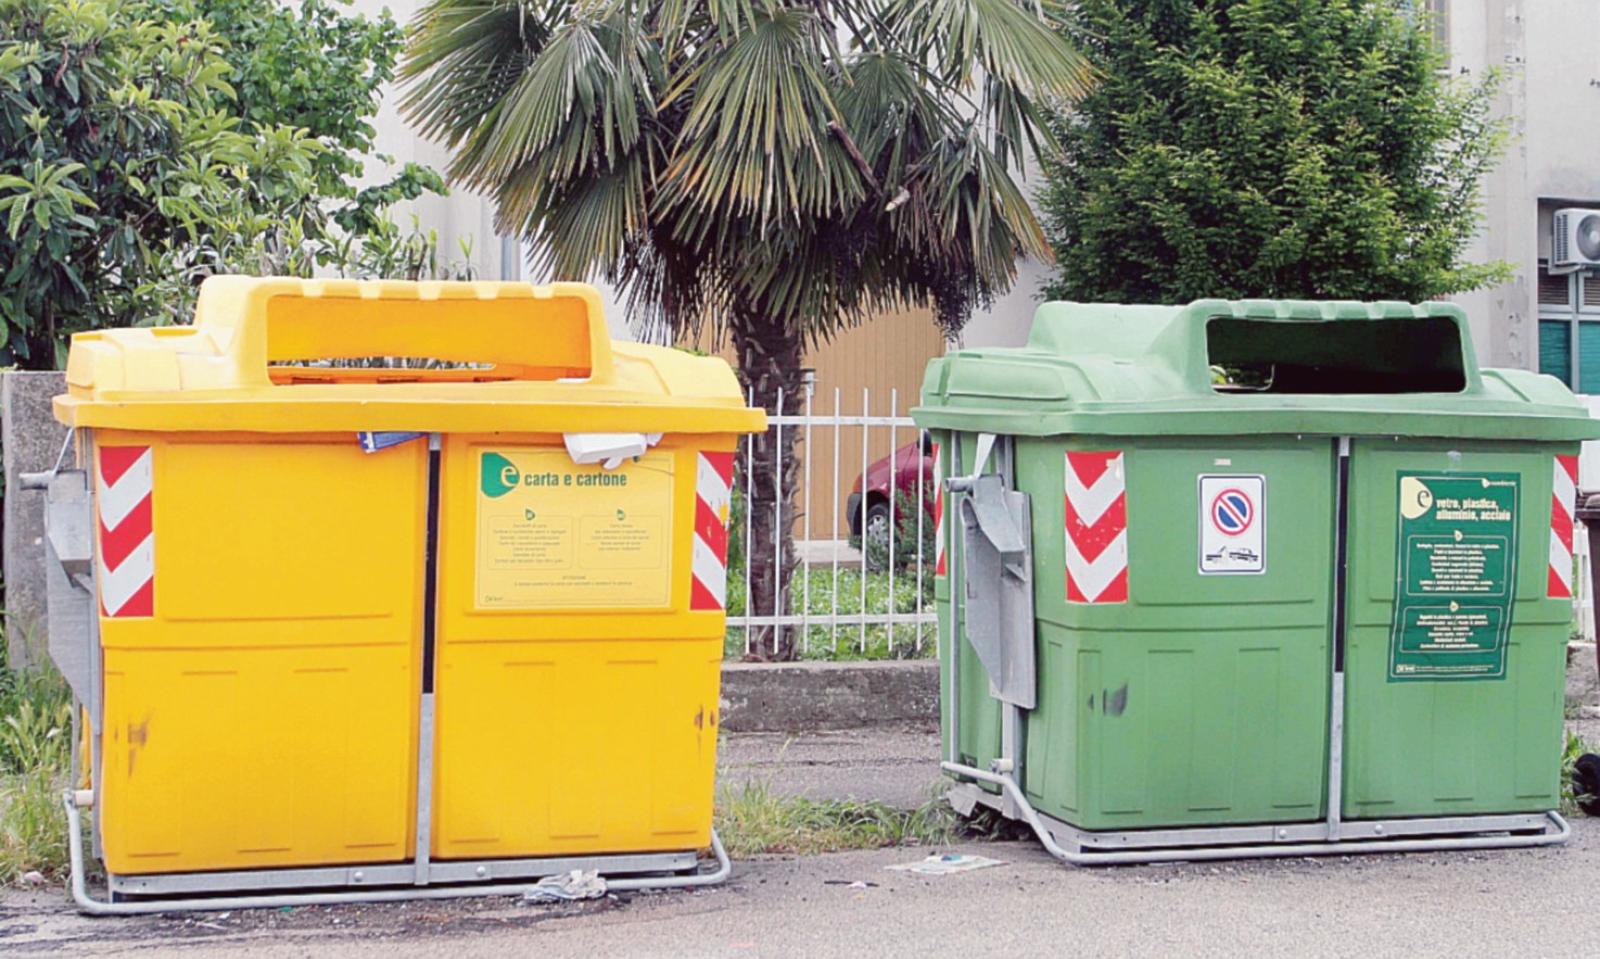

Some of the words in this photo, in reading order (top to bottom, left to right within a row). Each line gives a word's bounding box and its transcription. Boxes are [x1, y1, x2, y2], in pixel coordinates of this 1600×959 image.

[524, 472, 559, 486] carta
[563, 474, 572, 486] e
[576, 472, 627, 486] cartone
[1436, 498, 1460, 510] vetro,
[1462, 498, 1499, 511] plastica,
[1436, 510, 1479, 521] alluminio,
[1480, 510, 1511, 520] acciaio
